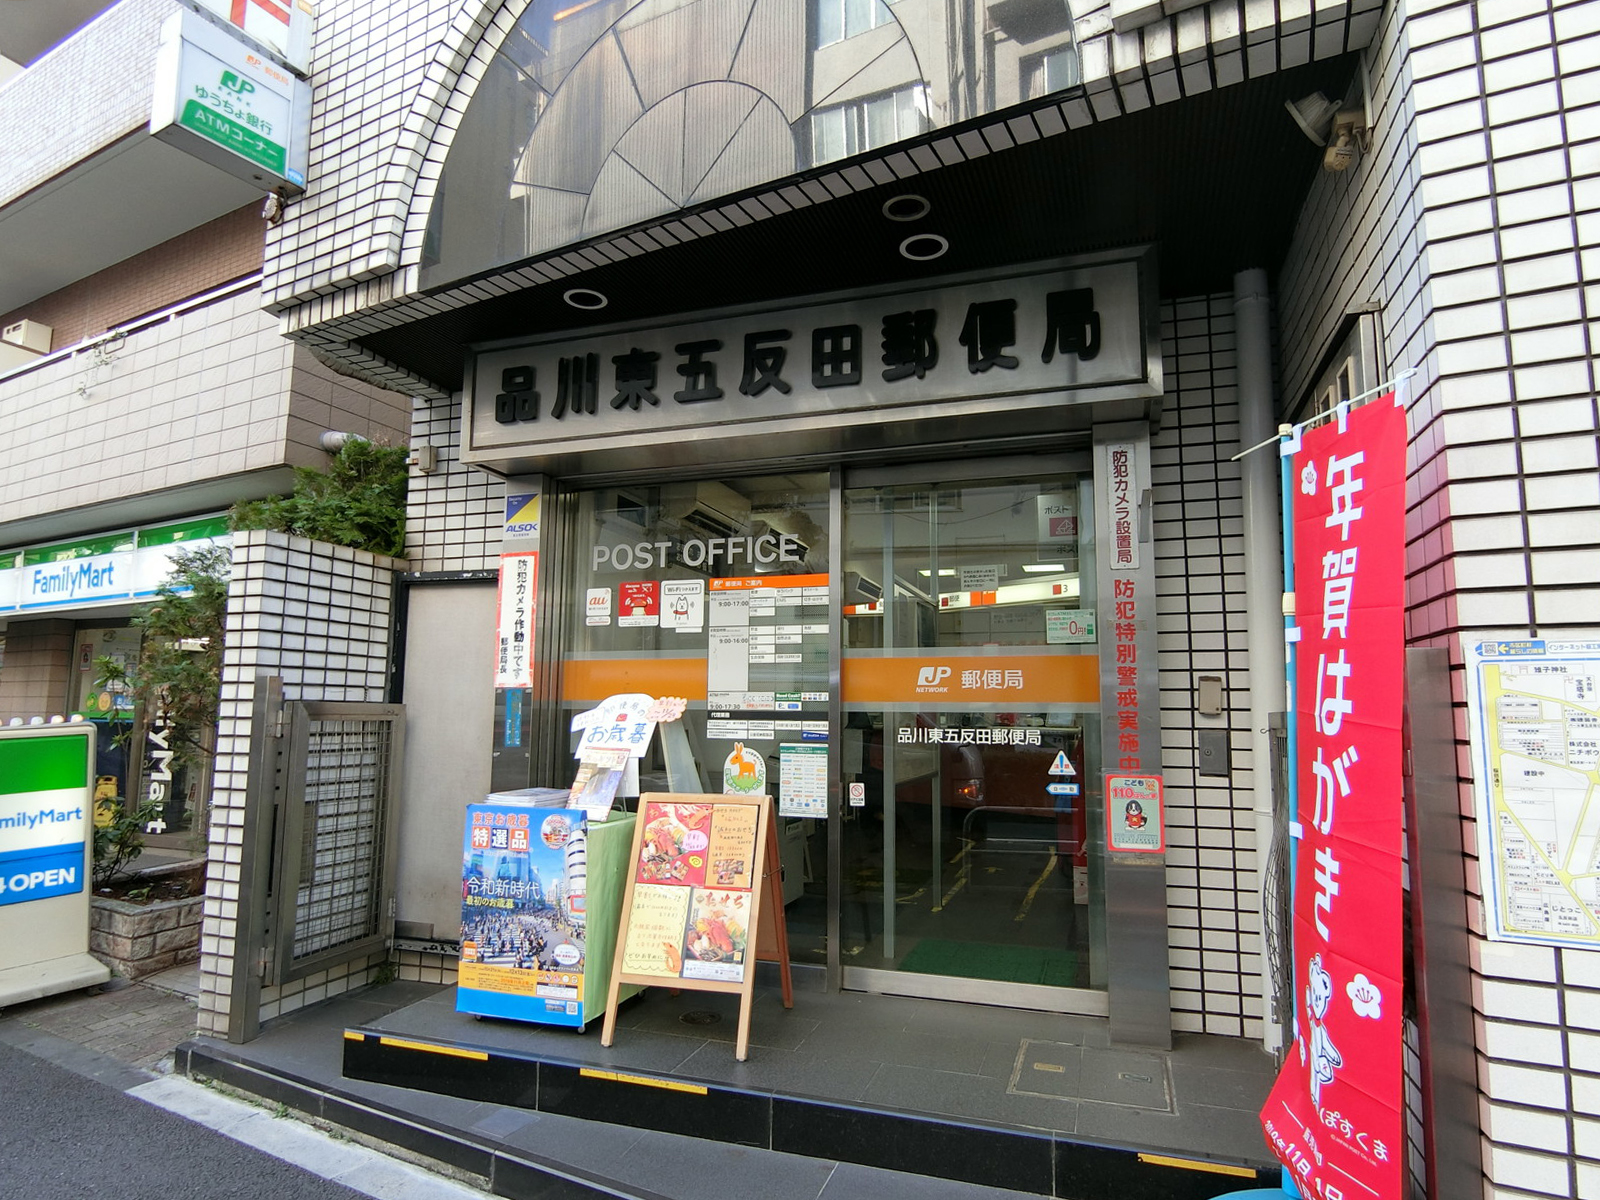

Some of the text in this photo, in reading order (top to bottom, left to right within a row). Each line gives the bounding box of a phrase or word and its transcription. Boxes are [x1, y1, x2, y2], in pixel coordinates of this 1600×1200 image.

[195, 84, 274, 136] ゆうちょ銀行
[194, 109, 279, 157] ATMコーナー
[495, 287, 1101, 424] 品川東五反田郵便局
[1044, 505, 1070, 515] ポスト
[1112, 450, 1133, 564] 防犯カメラ設置局
[506, 523, 538, 533] ALSOK
[592, 541, 672, 571] POST
[682, 533, 800, 567] OFFICE
[33, 560, 115, 597] FamilyMart
[1063, 584, 1069, 593] 3
[589, 597, 608, 606] au
[513, 559, 528, 680] 防犯カメラ作動中です
[917, 666, 1024, 690] JP 郵便局
[1114, 579, 1141, 774] 防犯特別警戒実施中
[1312, 451, 1364, 942] 年賀はがき
[587, 723, 647, 743] お歳暮
[897, 728, 1041, 746] 品川東五反田郵便局
[1124, 779, 1144, 787] こども
[472, 812, 530, 827] 東京お歳暮
[472, 826, 530, 851] 特選品
[9, 867, 75, 892] OPEN
[466, 877, 541, 899] 令和新時代
[1319, 1107, 1389, 1162] ぽすくま
